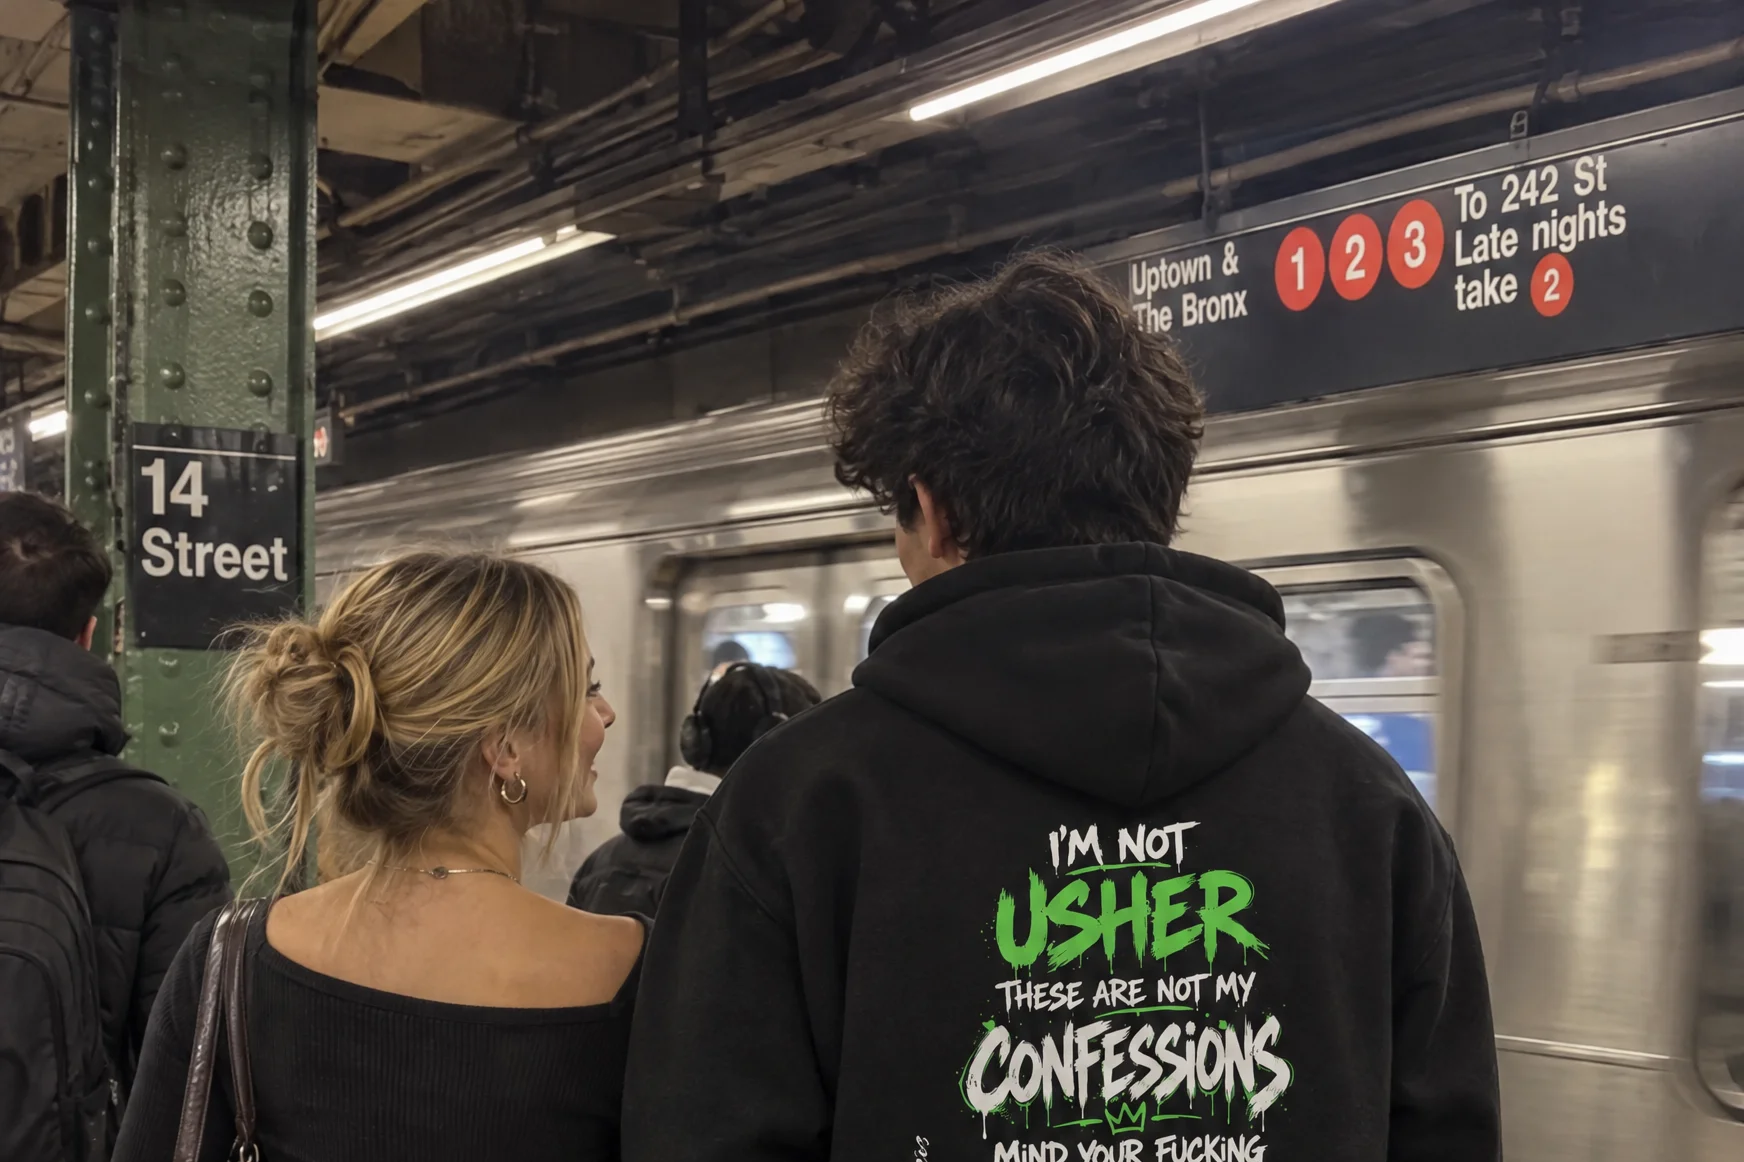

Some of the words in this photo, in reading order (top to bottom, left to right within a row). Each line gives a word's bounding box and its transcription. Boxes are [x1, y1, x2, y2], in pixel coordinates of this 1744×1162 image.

[1454, 183, 1488, 223] To
[1501, 164, 1559, 213] 242
[1573, 154, 1608, 196] St
[1290, 246, 1306, 291] 1
[1344, 233, 1367, 281] 2
[1403, 219, 1427, 269] 3
[1455, 223, 1519, 267] Late
[1532, 200, 1627, 253] nights
[1131, 254, 1212, 300] Uptown
[1221, 240, 1240, 277] &
[1454, 268, 1518, 311] take
[1543, 267, 1561, 303] 2
[1132, 301, 1173, 334] The
[1181, 289, 1249, 328] Bronx
[141, 457, 209, 518] 14
[141, 527, 289, 582] Street
[1049, 824, 1104, 875] I'M
[1118, 821, 1201, 873] NOT
[995, 867, 1271, 977] USHER
[995, 978, 1085, 1014] THESE
[1092, 977, 1148, 1009] ARE
[1157, 973, 1213, 1008] NOT
[1215, 971, 1257, 1007] MY
